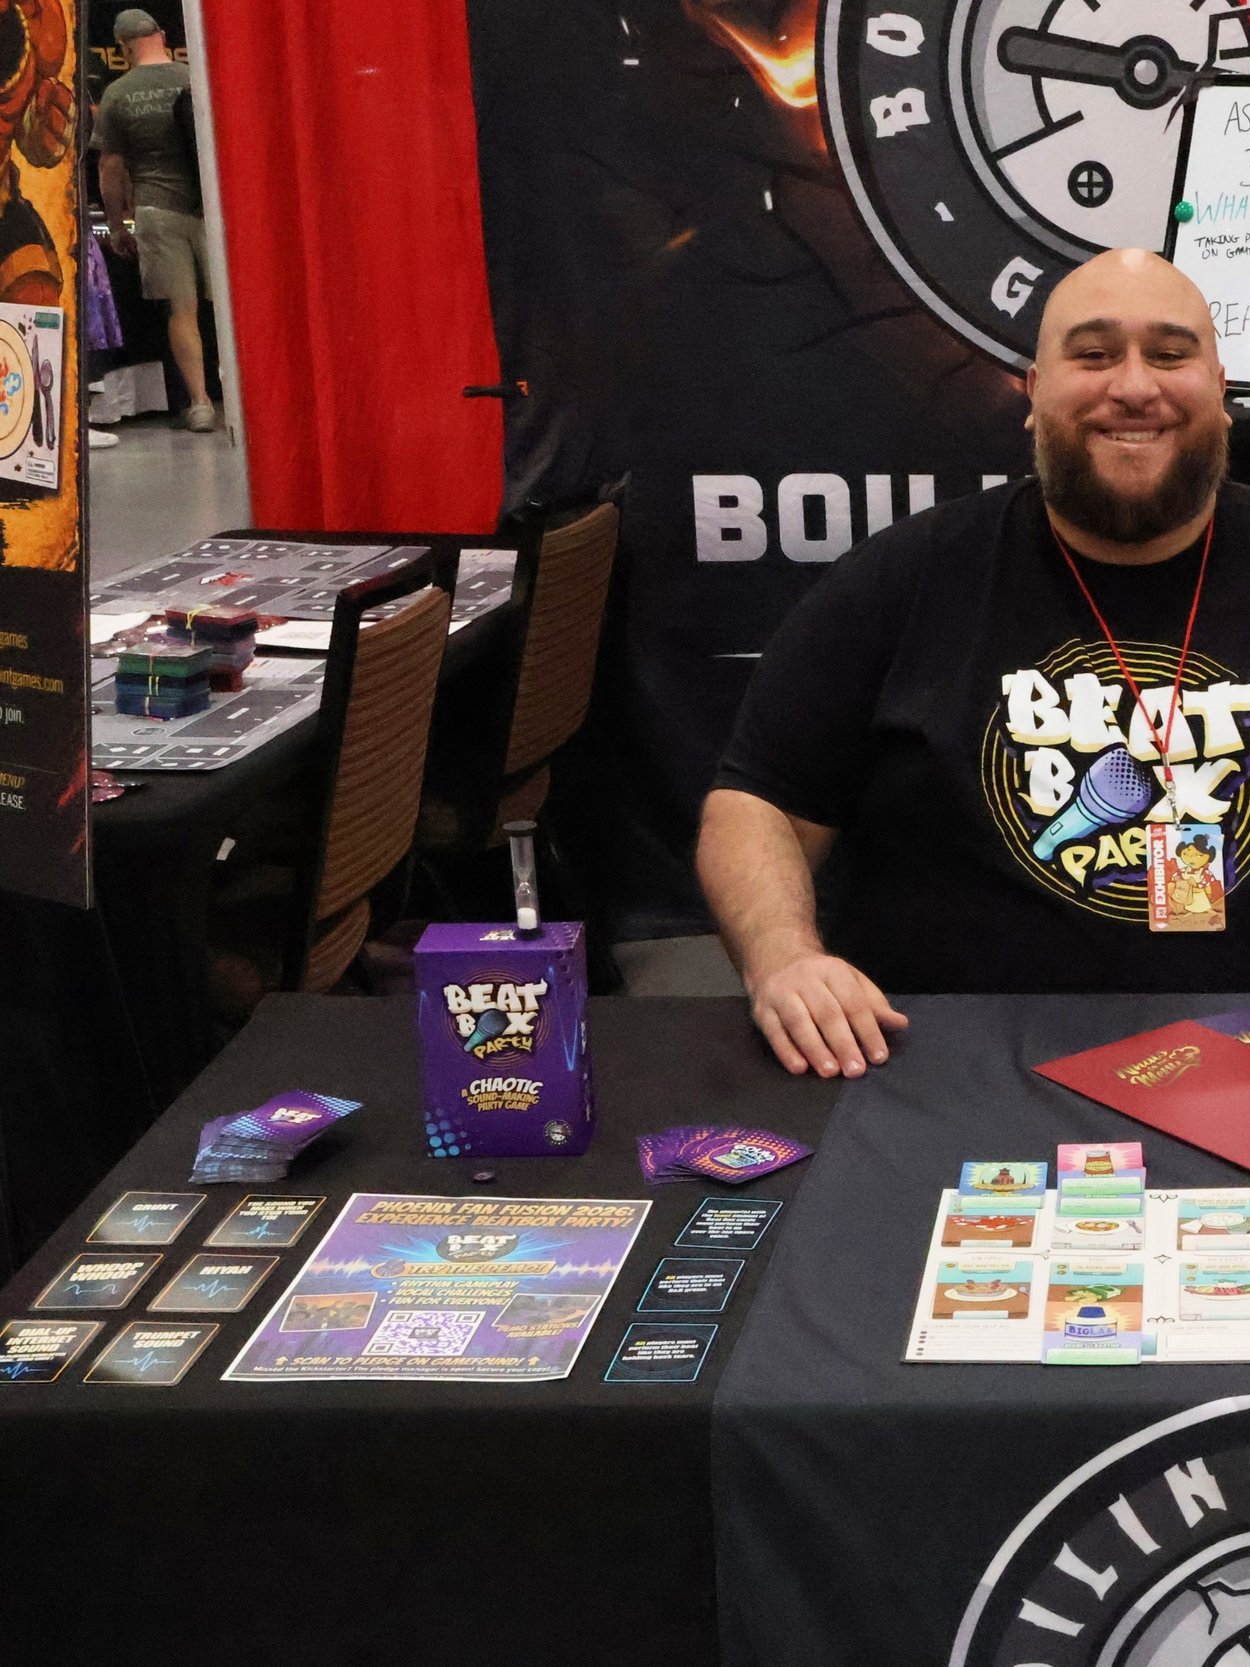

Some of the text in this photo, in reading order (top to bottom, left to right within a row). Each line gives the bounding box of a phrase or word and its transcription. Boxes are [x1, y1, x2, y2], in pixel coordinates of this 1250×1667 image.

[1194, 234, 1240, 248] TAKING
[1202, 248, 1219, 259] ON
[1061, 827, 1147, 885] PAR
[1153, 839, 1167, 906] EXHIBITOR
[444, 978, 548, 1014] BEAT
[473, 1036, 532, 1059] PARTY
[470, 1077, 543, 1094] CHAOTIC
[467, 1091, 539, 1105] SOUND-MAKING
[478, 1100, 530, 1112] PARTY GAME
[370, 1201, 636, 1217] PHOENIX FAN FUSION 2026:
[355, 1212, 634, 1228] EXPERIENCE BEATBOX PARTY!
[447, 1234, 517, 1244] BEAT
[77, 1262, 144, 1273] WHOOP
[199, 1265, 254, 1275] HIYAH
[408, 1262, 545, 1274] TRY THE DEMO!
[69, 1270, 138, 1282] WHOOP
[399, 1280, 520, 1288] RHYTHM GAMEPLAY
[395, 1289, 514, 1297] VOCAL CHALLENGES
[388, 1297, 512, 1305] FUN FOR EVERYONE!
[18, 1327, 78, 1337] DIAL-UP
[133, 1331, 201, 1340] TRUMPET
[5, 1335, 77, 1346] INTERNET
[133, 1339, 186, 1349] SOUND
[7, 1344, 61, 1354] SOUND
[290, 1357, 526, 1366] SCAN TO PLEDGE ON GAMEFOUND!
